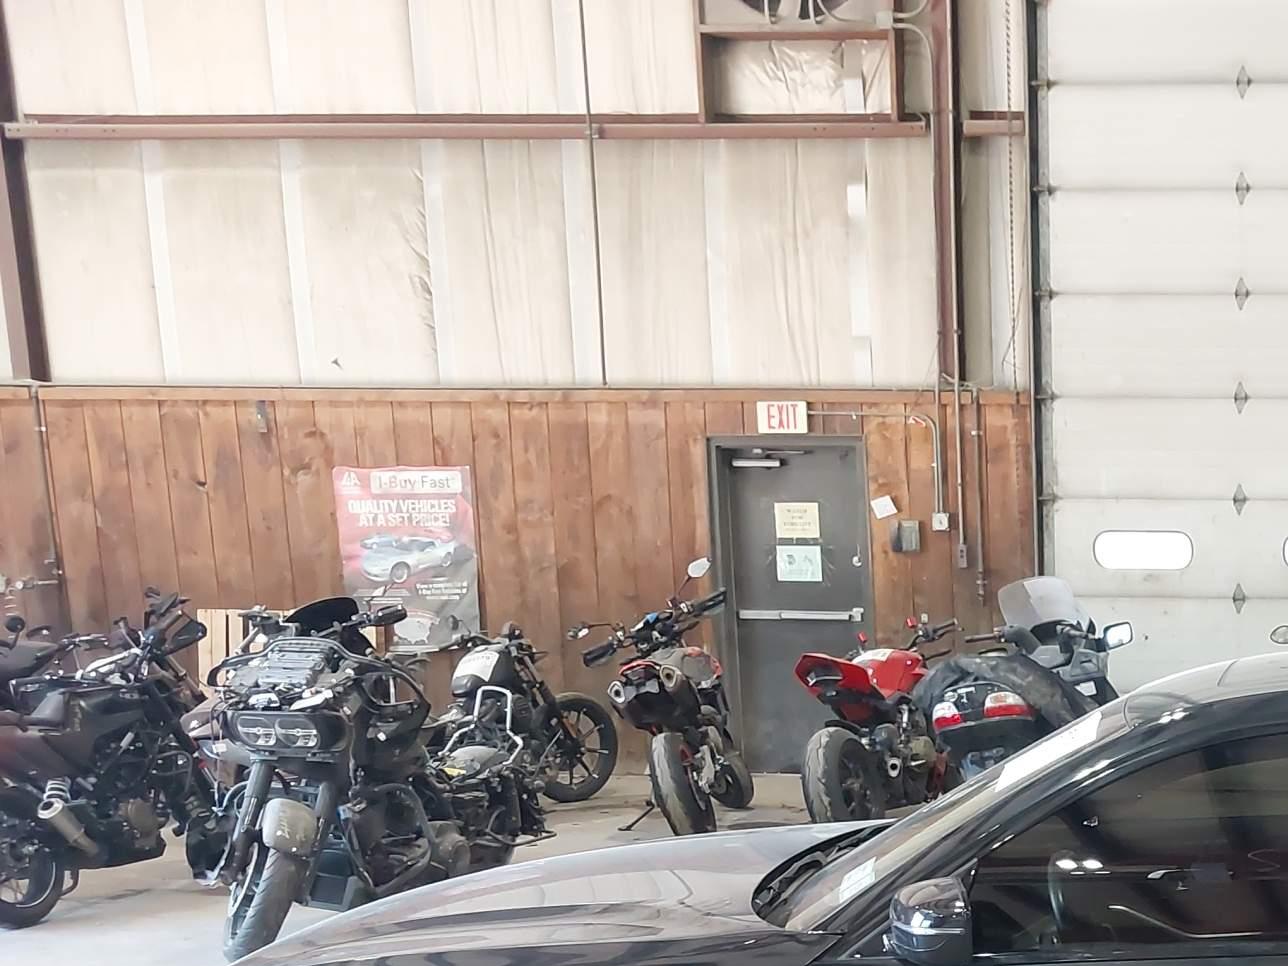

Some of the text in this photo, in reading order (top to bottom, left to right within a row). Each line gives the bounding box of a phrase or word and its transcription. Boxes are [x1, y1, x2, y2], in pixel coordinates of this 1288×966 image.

[767, 403, 798, 430] EXIT
[377, 475, 417, 490] I-Buy
[348, 499, 457, 514] QUALITY VEHICLES
[358, 513, 451, 527] AT A SET PRICE!
